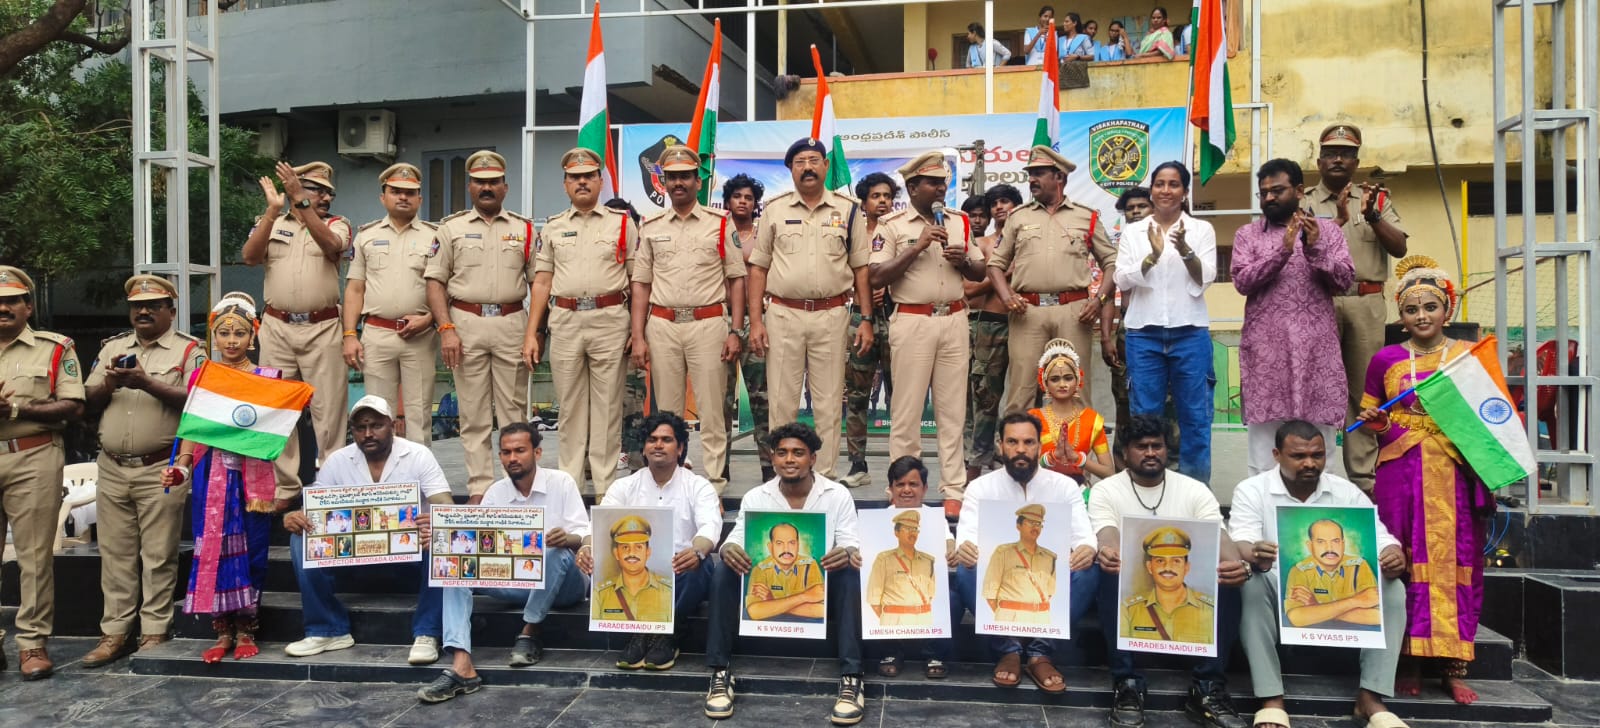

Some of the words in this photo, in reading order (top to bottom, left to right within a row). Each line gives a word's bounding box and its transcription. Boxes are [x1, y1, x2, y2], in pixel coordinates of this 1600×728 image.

[1092, 120, 1146, 131] VISAKHAPATNAM
[318, 558, 354, 567] INSPECTOR
[598, 622, 652, 631] PARADESINAIDU
[983, 623, 1010, 633] UMESH
[1011, 625, 1049, 635] CHANDRA
[1049, 627, 1062, 635] IPS
[869, 628, 895, 636] UMESH
[895, 628, 931, 636] CHANDRA
[1301, 632, 1308, 640] K
[1317, 633, 1344, 641] VYASS
[1345, 634, 1359, 642] IPS
[1128, 640, 1168, 651] PARADESI
[1168, 644, 1193, 653] NAIDU
[1195, 645, 1208, 653] IPS
